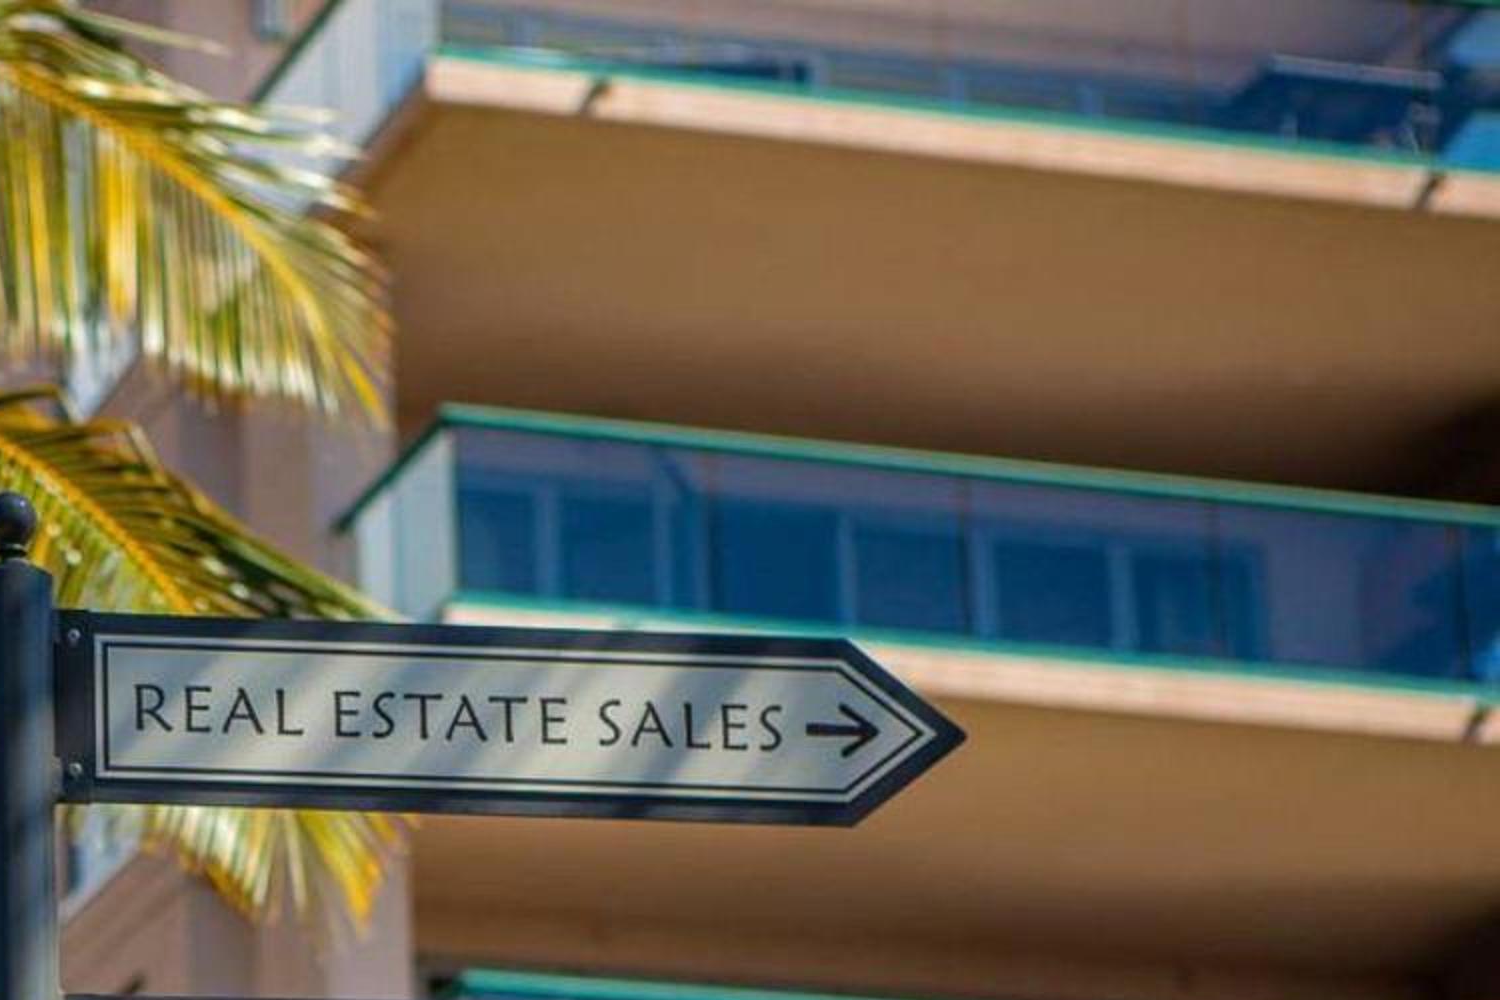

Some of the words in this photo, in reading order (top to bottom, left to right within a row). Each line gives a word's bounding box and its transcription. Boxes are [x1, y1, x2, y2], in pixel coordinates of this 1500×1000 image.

[133, 684, 305, 737] REAL
[333, 689, 570, 745] ESTATE
[599, 699, 784, 752] SALES
